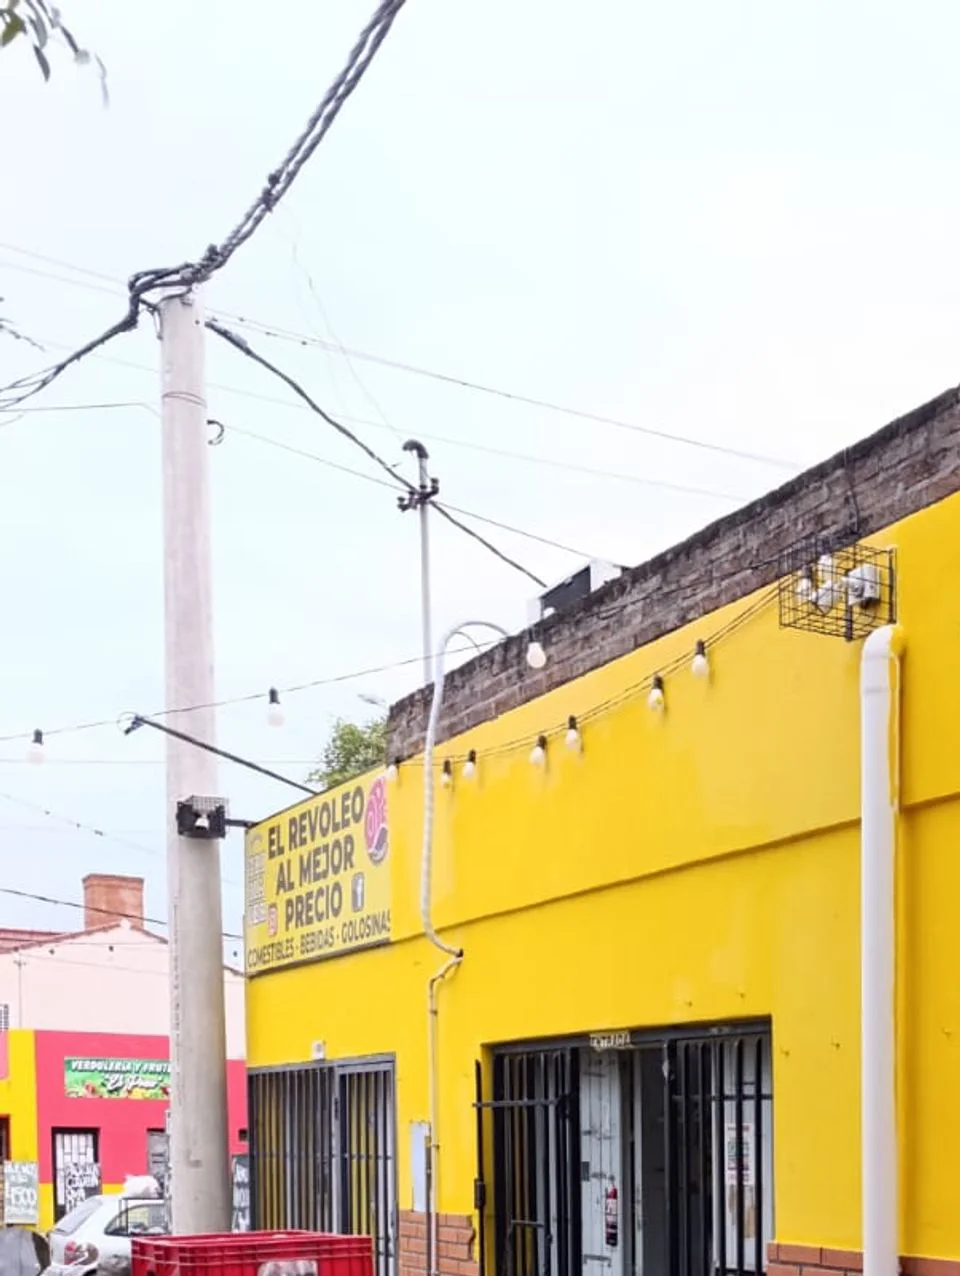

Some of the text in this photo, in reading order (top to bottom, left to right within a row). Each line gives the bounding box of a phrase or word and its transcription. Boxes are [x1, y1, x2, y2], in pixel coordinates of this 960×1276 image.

[268, 824, 285, 859] EL
[288, 786, 365, 851] REVOLEO
[276, 859, 295, 895] AL
[299, 834, 355, 887] MEJOR
[285, 881, 343, 931] PRECIO
[248, 937, 294, 967] COMESTIBLES
[300, 926, 334, 954] BEBIDAS
